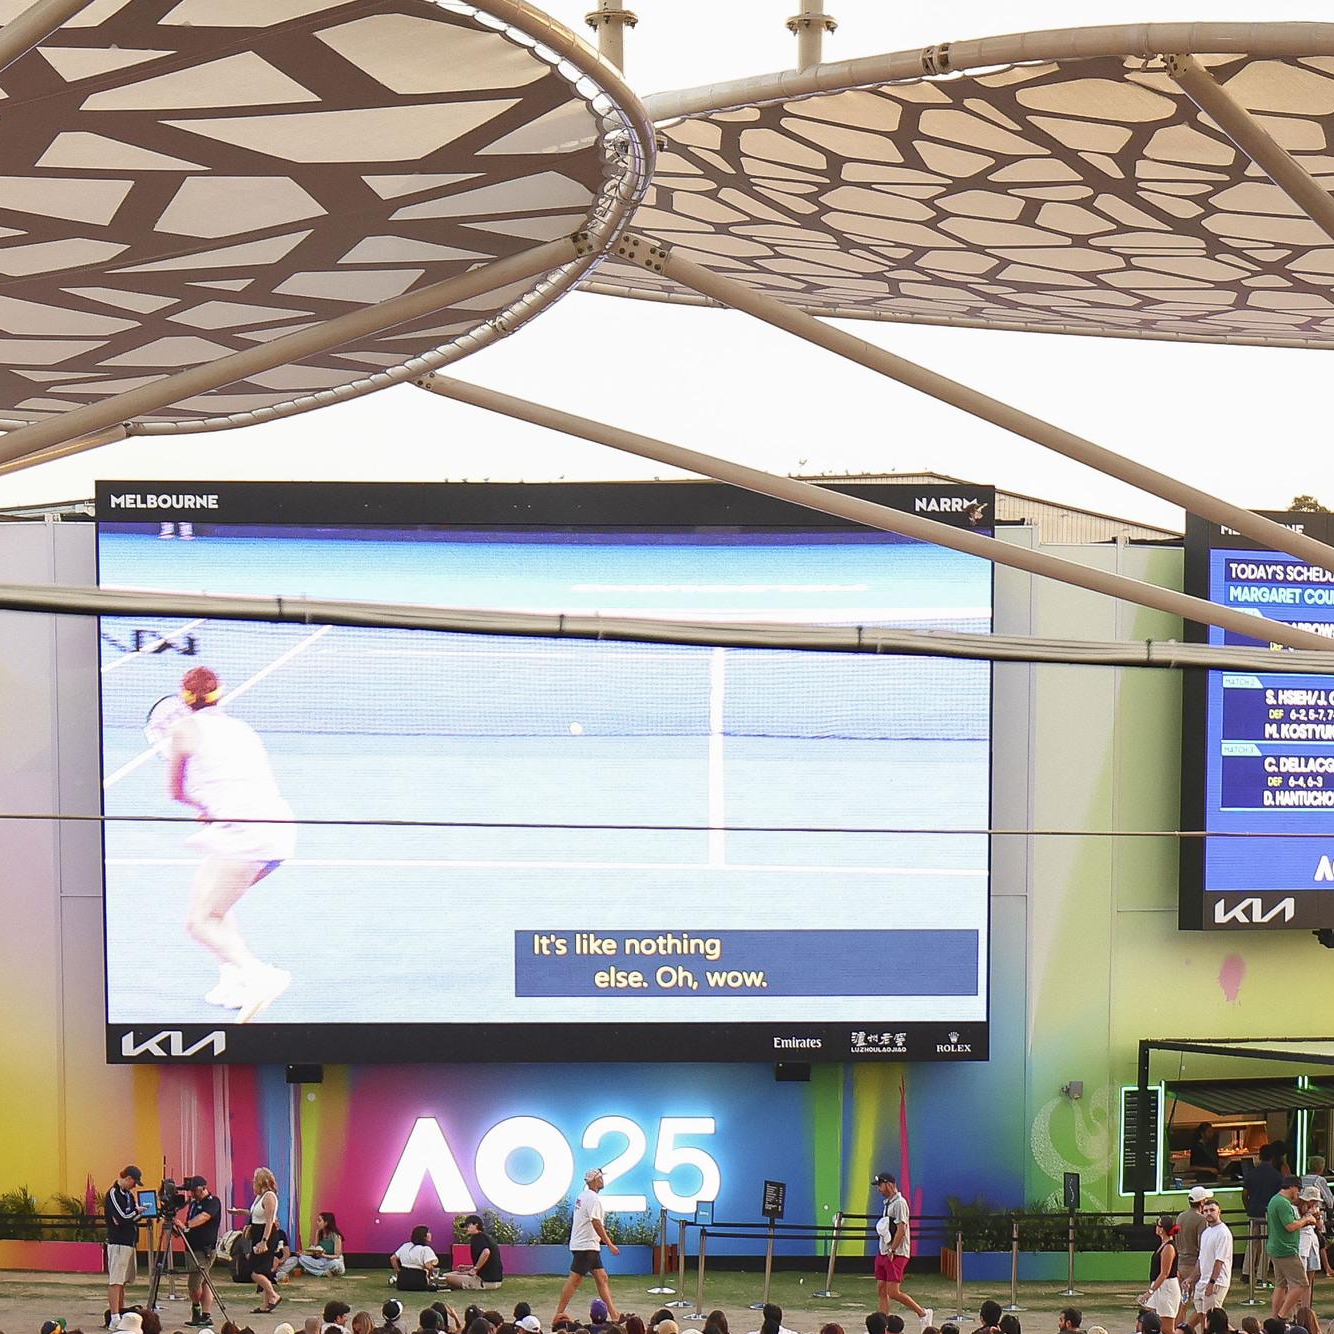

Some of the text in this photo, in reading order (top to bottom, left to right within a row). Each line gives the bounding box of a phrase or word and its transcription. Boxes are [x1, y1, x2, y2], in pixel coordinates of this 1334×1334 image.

[110, 494, 219, 509] MELBOURNE
[1229, 563, 1284, 581] TODAY'S
[1229, 586, 1303, 604] MARGARET
[1268, 709, 1284, 719] DEF
[1268, 777, 1283, 787] DEF
[1214, 897, 1295, 924] KIA
[533, 933, 721, 961] It's like nothing
[594, 965, 768, 991] else. Oh, wow.
[122, 1031, 226, 1056] KIA
[773, 1036, 822, 1049] Emirates
[936, 1044, 971, 1053] ROLEX
[378, 1115, 722, 1217] AO25
